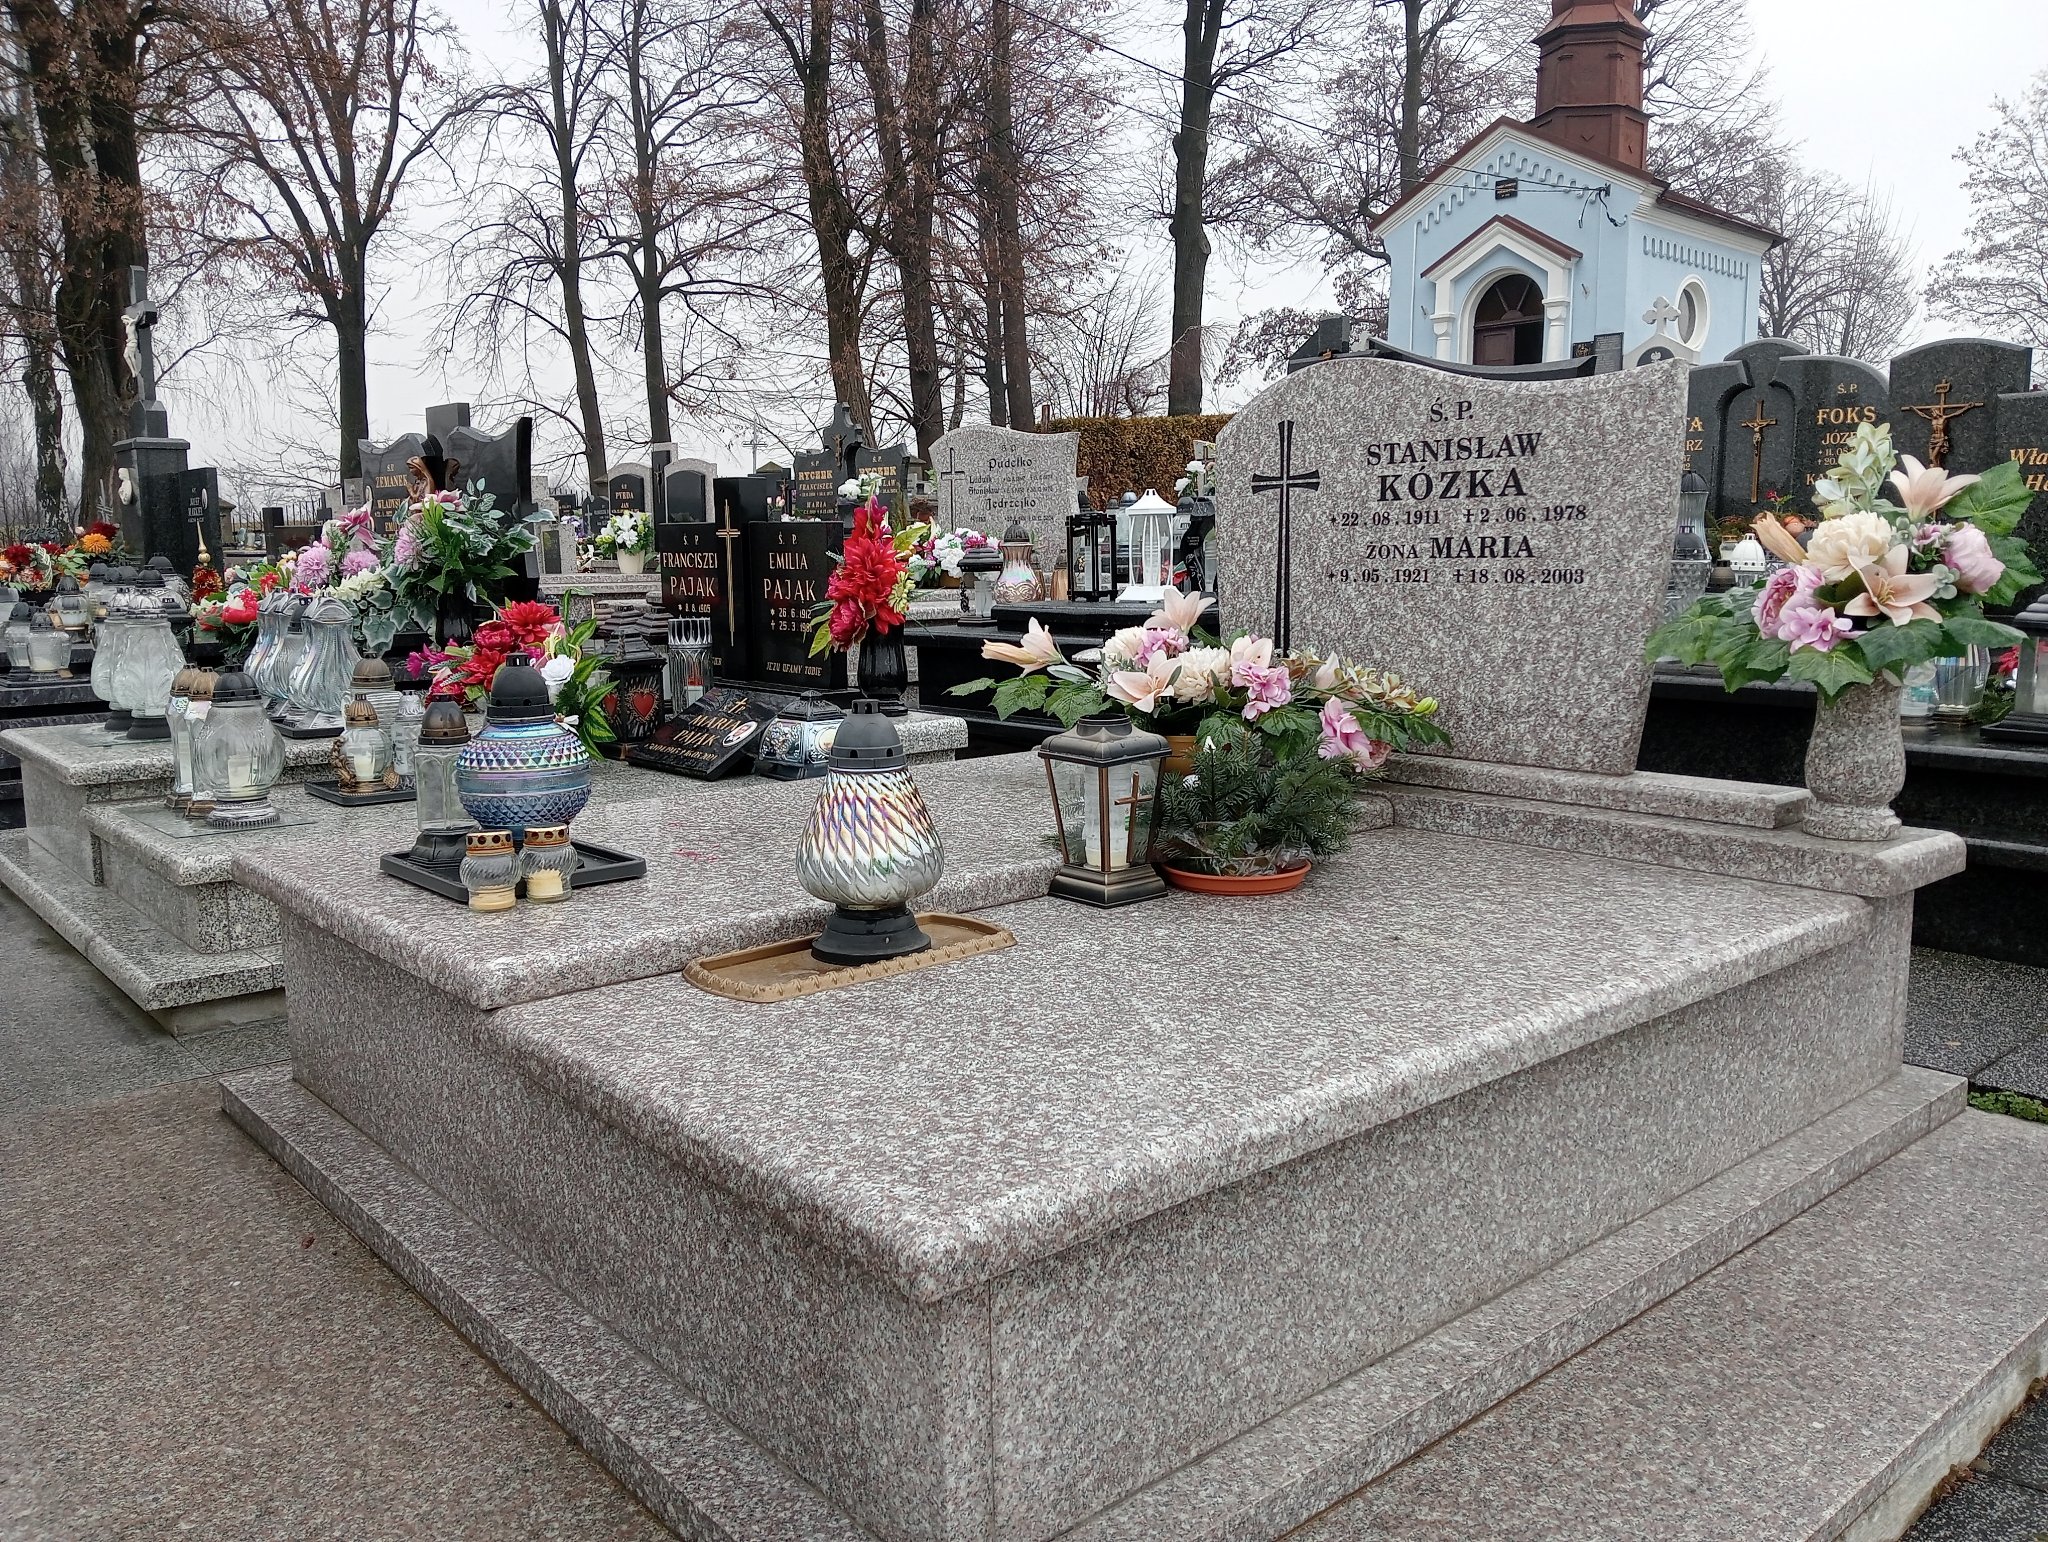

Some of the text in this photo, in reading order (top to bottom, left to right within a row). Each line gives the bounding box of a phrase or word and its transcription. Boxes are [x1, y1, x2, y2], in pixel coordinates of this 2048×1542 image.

[1430, 397, 1474, 422] Ś. P.
[1816, 406, 1877, 425] FOKS
[1367, 432, 1542, 466] STANISŁAW
[1377, 466, 1527, 502] KÓZKA
[1366, 535, 1537, 559] ŻONA MARIA
[769, 552, 808, 570] EMILIA
[670, 576, 716, 599] PAJĄK
[763, 578, 816, 604] PAJĄK
[688, 714, 742, 731] MARIA
